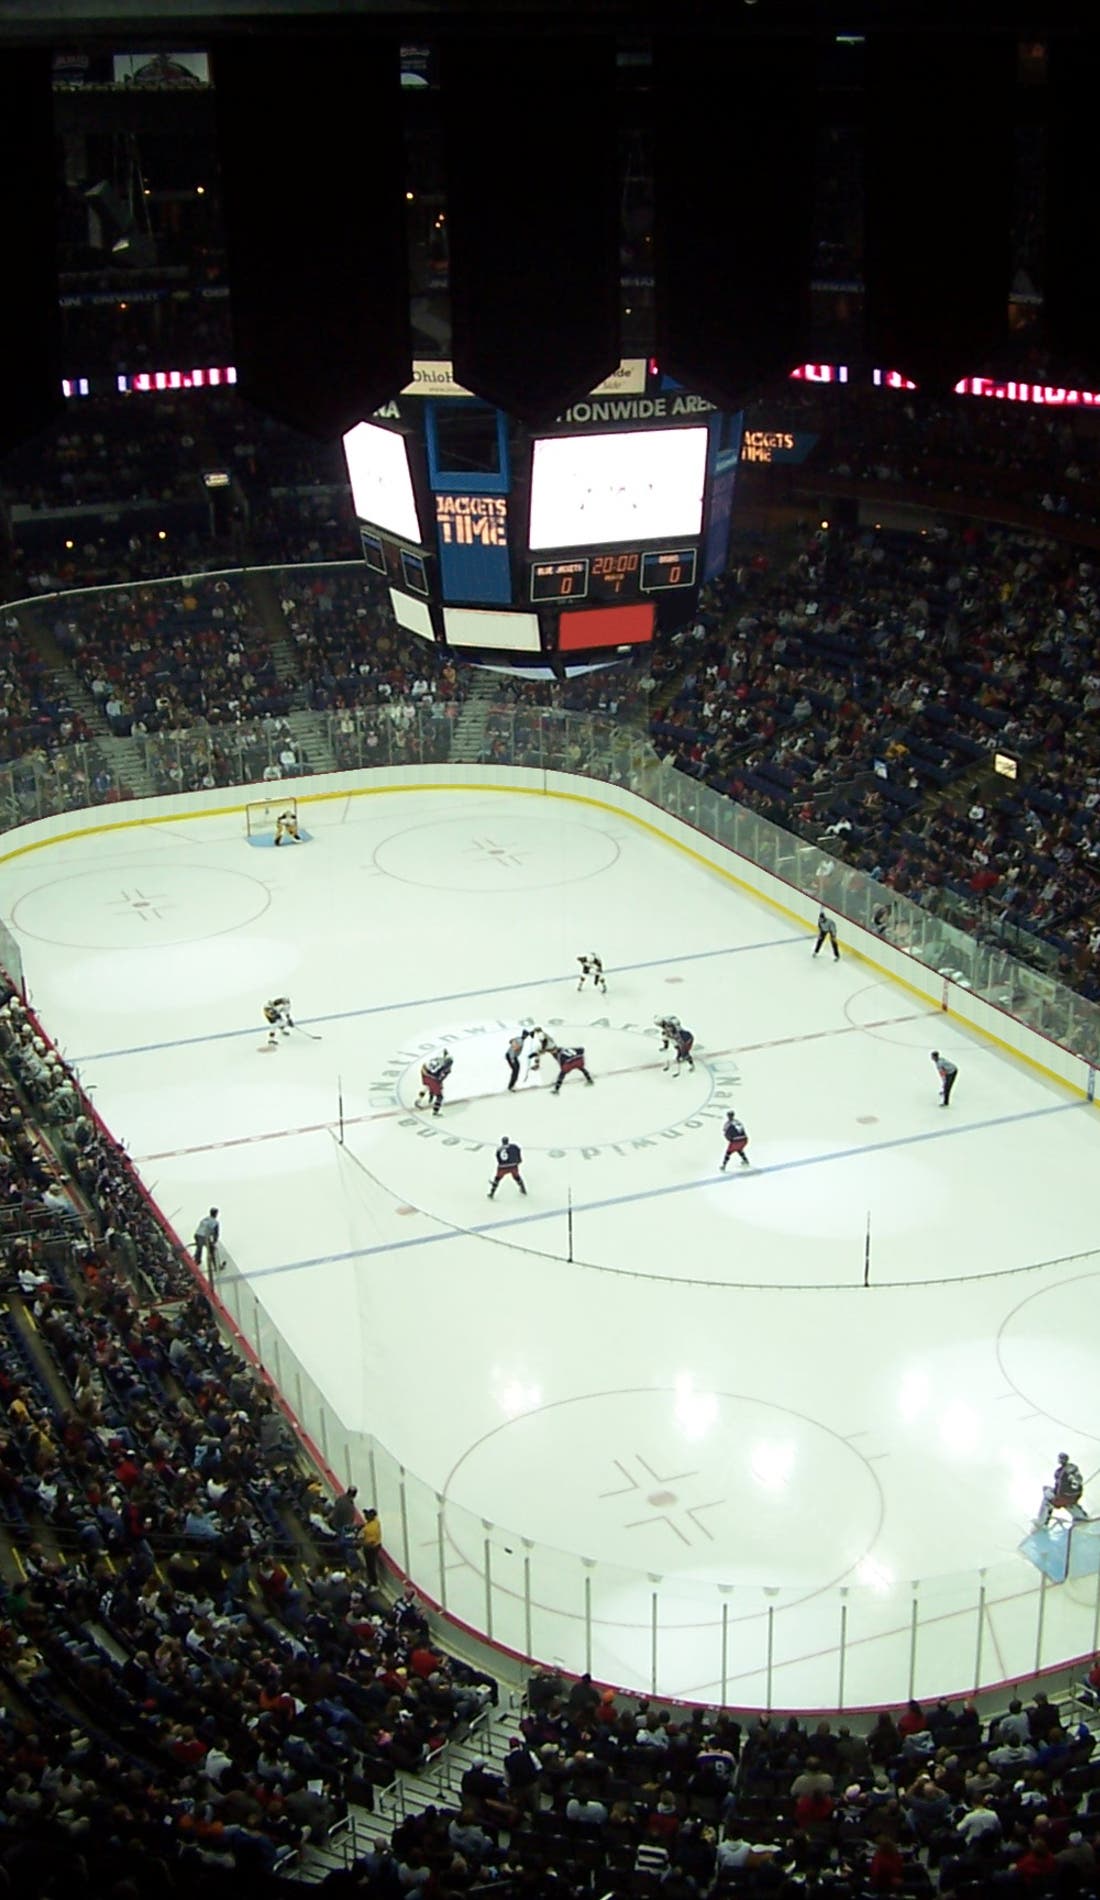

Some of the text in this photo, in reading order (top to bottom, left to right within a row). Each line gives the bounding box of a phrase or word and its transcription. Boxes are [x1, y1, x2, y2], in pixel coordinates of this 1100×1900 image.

[556, 398, 666, 423] IONWIDE
[436, 496, 507, 516] JACKETS
[437, 513, 507, 546] TIME
[591, 554, 640, 575] 20:00
[669, 566, 682, 584] 0
[560, 577, 573, 595] 0
[589, 1017, 705, 1051] Area
[500, 1148, 508, 1161] 6
